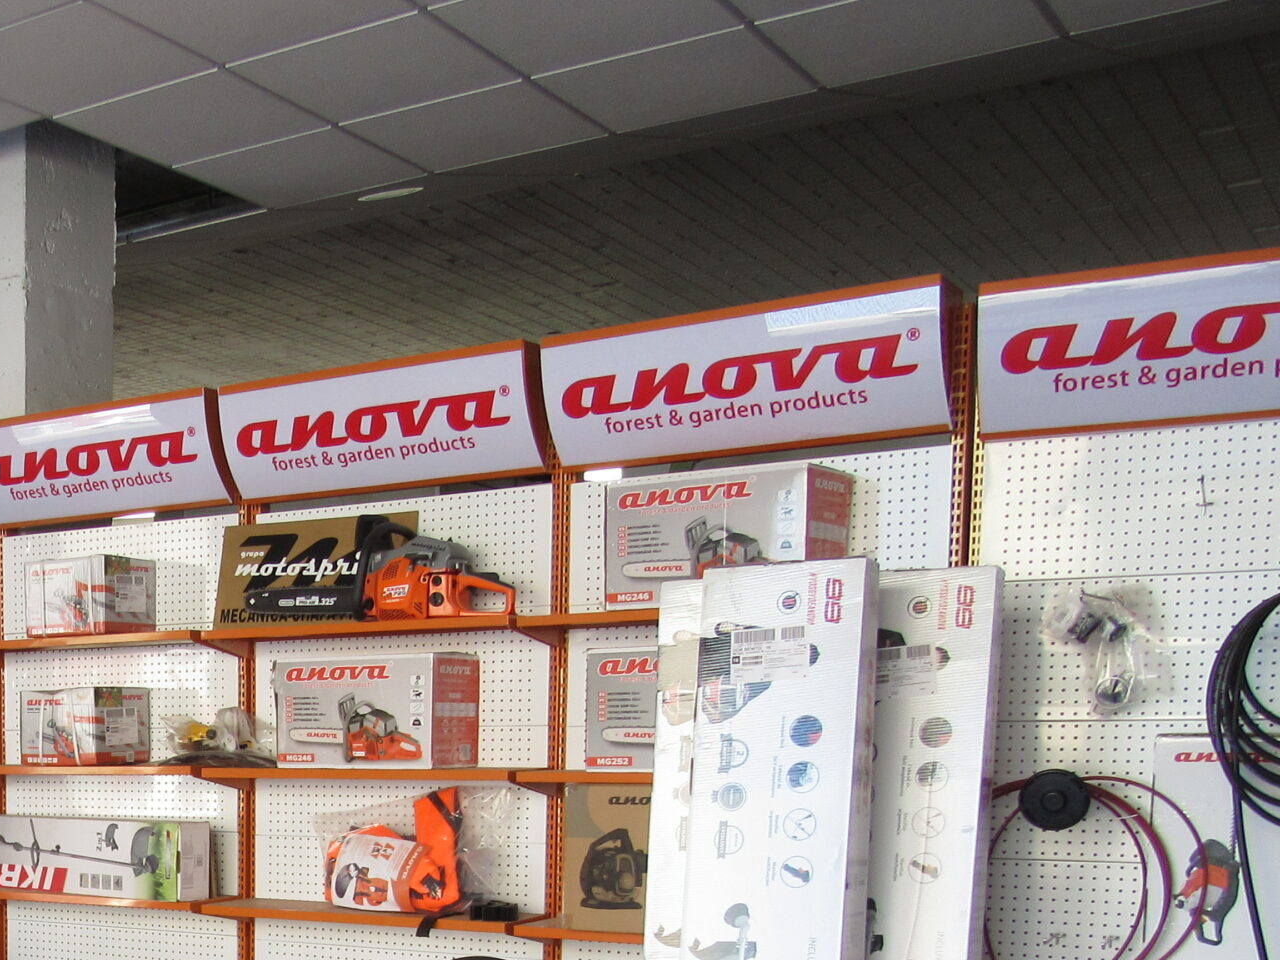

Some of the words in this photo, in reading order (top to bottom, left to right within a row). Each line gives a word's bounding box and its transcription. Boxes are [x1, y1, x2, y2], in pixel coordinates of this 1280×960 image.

[1000, 301, 1280, 374] ano
[561, 334, 918, 419] anova
[1053, 369, 1129, 393] forest
[1137, 365, 1156, 385] &
[1165, 357, 1264, 388] garden
[236, 390, 511, 458] anova
[604, 413, 662, 434] forest
[669, 409, 684, 426] &
[689, 398, 763, 428] garden
[769, 387, 868, 418] products
[272, 452, 318, 472] forest
[321, 452, 333, 466] &
[337, 444, 395, 468] garden
[399, 435, 476, 460] products
[10, 485, 48, 501] forest
[49, 483, 60, 497] &
[63, 478, 109, 498] garden
[112, 471, 173, 491] products
[618, 481, 752, 510] anova
[234, 552, 361, 582] motospri
[240, 550, 265, 560] grupo
[617, 592, 650, 602] MG246
[286, 665, 390, 682] anova
[598, 656, 659, 677] ano
[286, 754, 312, 762] MG246
[596, 757, 629, 766] MG252
[608, 795, 651, 806] ano
